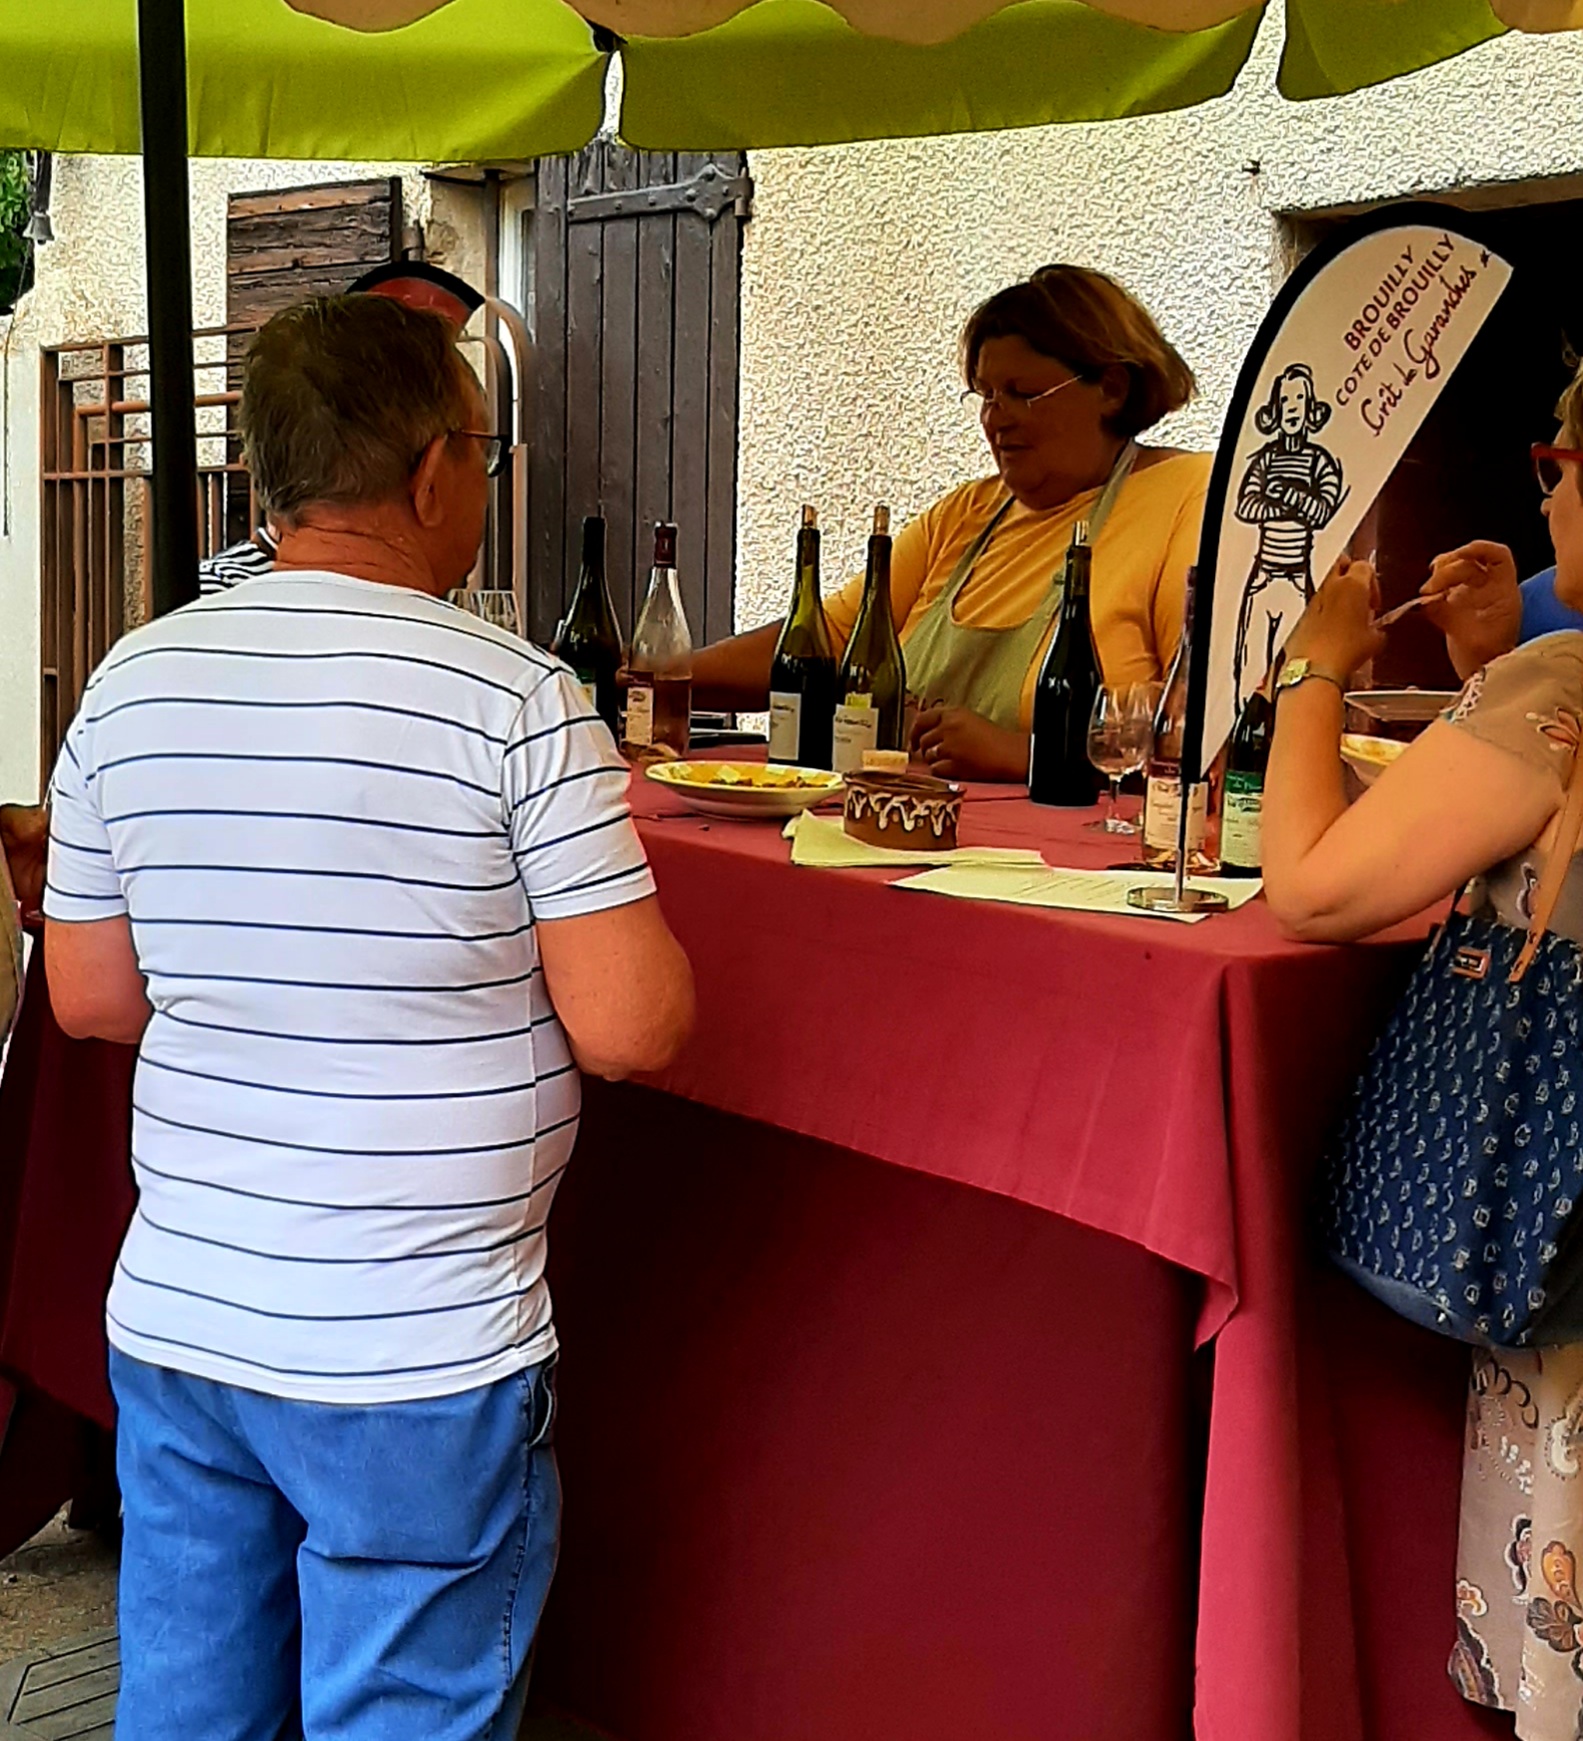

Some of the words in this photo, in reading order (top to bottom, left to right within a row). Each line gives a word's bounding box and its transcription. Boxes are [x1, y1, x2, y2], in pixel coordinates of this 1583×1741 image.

[1336, 354, 1373, 406] COTE
[1368, 328, 1391, 357] DE
[1386, 233, 1454, 330] BROUILLY
[1343, 245, 1414, 351] BROUILLY
